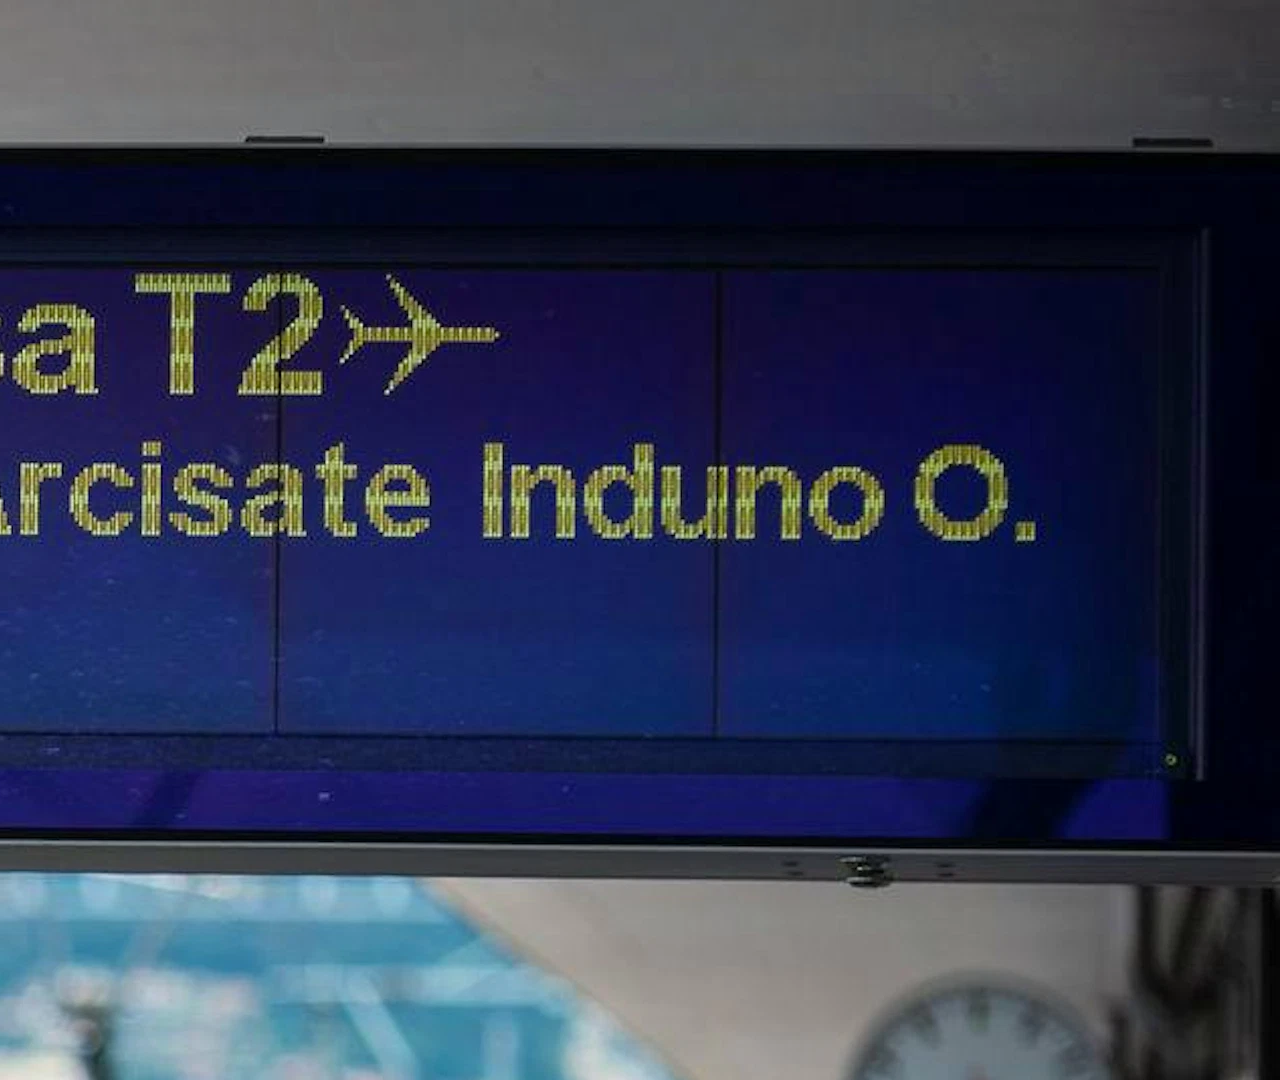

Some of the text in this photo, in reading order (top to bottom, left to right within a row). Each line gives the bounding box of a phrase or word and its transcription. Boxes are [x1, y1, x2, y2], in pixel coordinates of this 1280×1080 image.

[135, 273, 324, 396] T2
[482, 443, 886, 541] Induno
[914, 446, 1038, 542] O.
